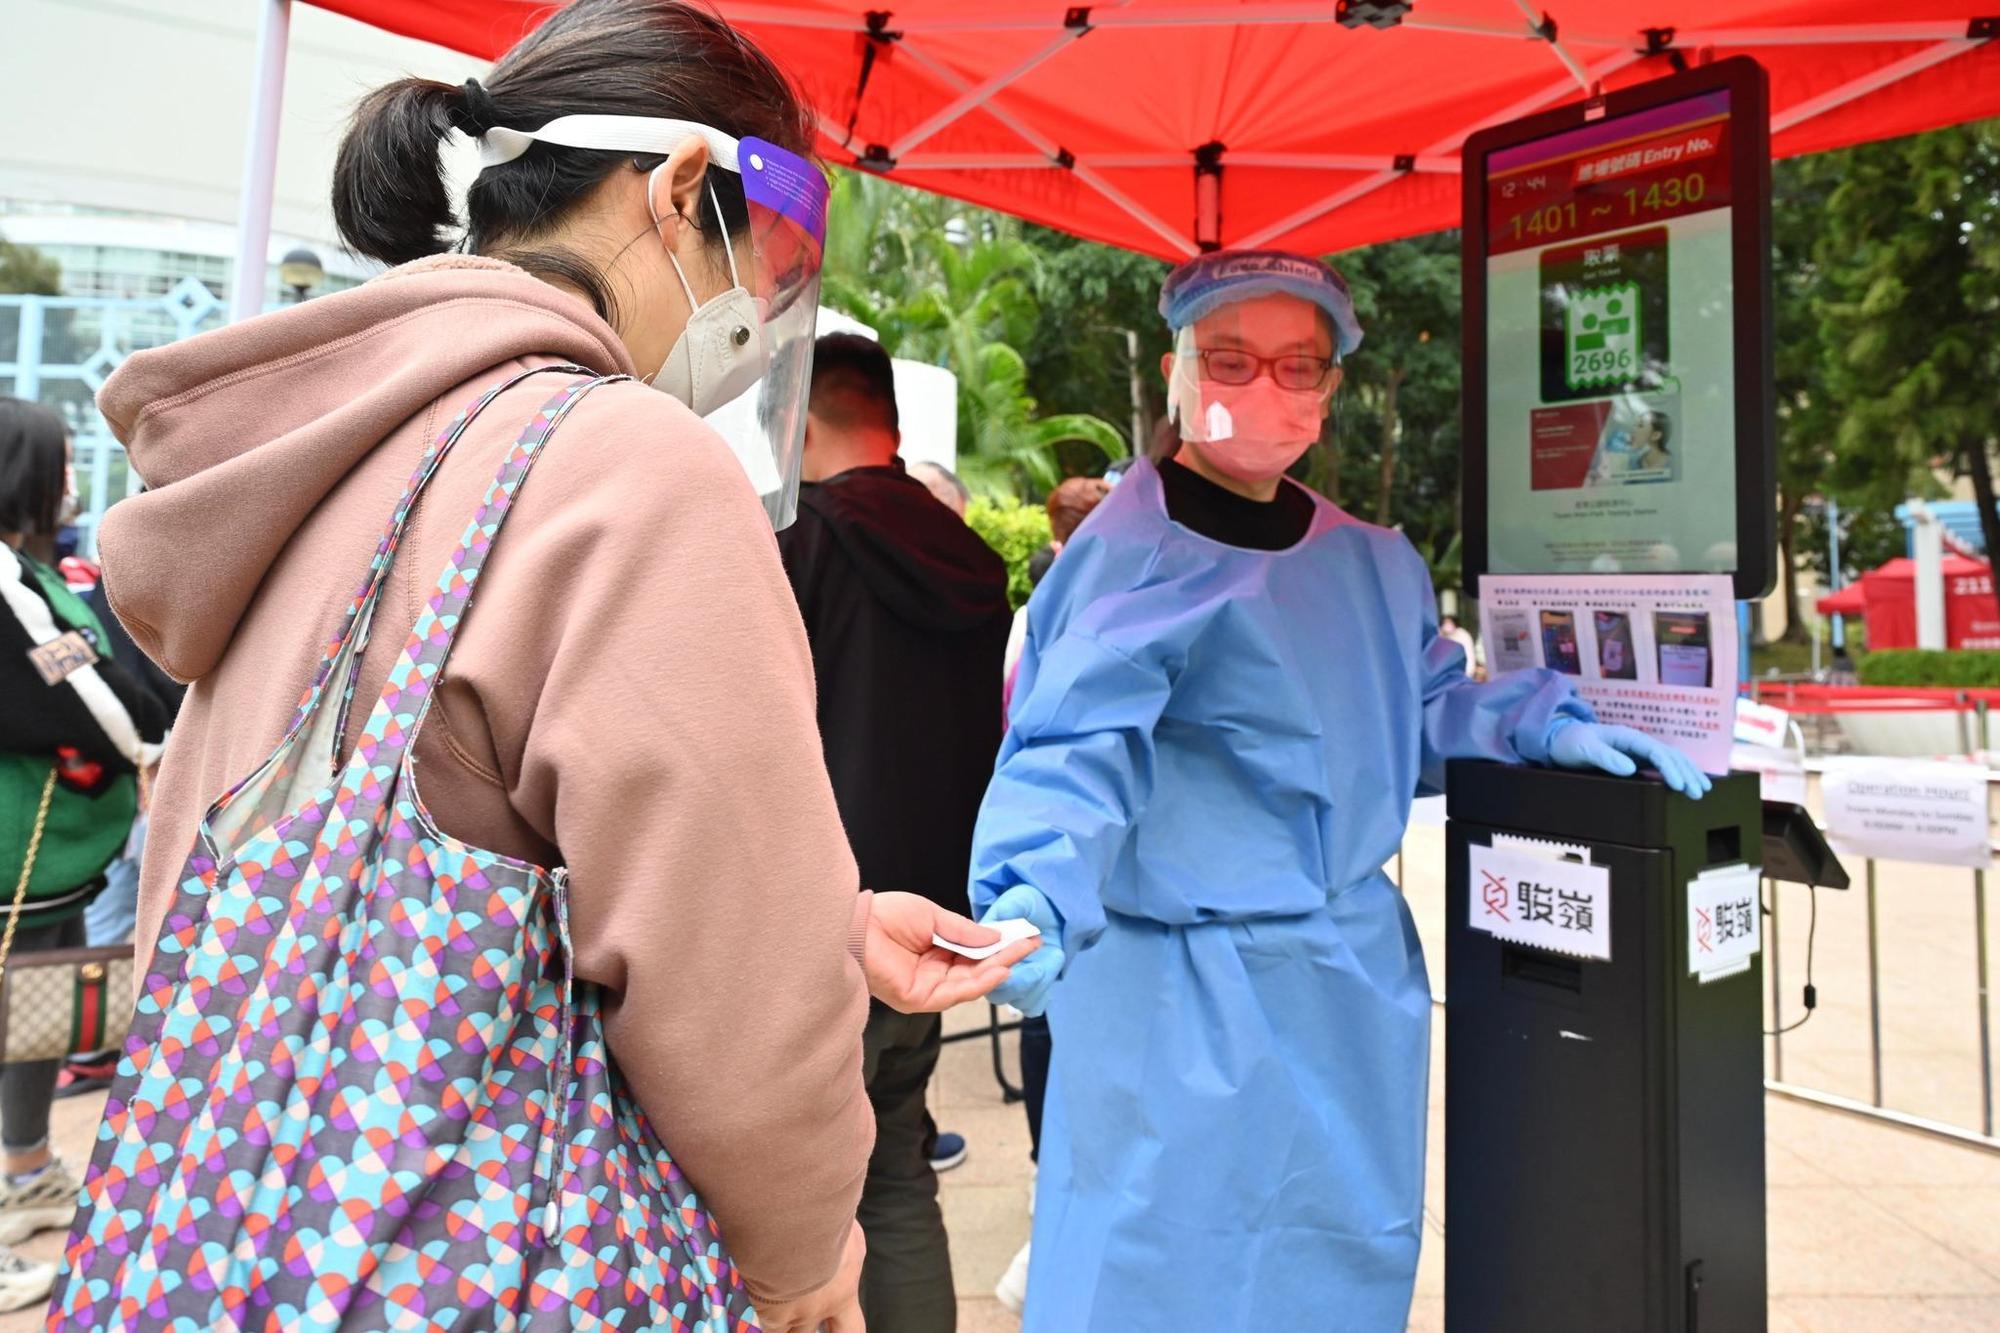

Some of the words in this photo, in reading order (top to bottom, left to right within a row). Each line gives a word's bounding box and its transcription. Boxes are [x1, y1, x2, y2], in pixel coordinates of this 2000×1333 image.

[1644, 144, 1684, 164] Entry
[1686, 138, 1713, 154] No.
[1510, 202, 1577, 240] 1401
[1624, 173, 1705, 216] 1430
[1574, 348, 1631, 375] 2696
[1517, 881, 1593, 934] 駿嶺
[1715, 897, 1753, 943] 駿嶺
